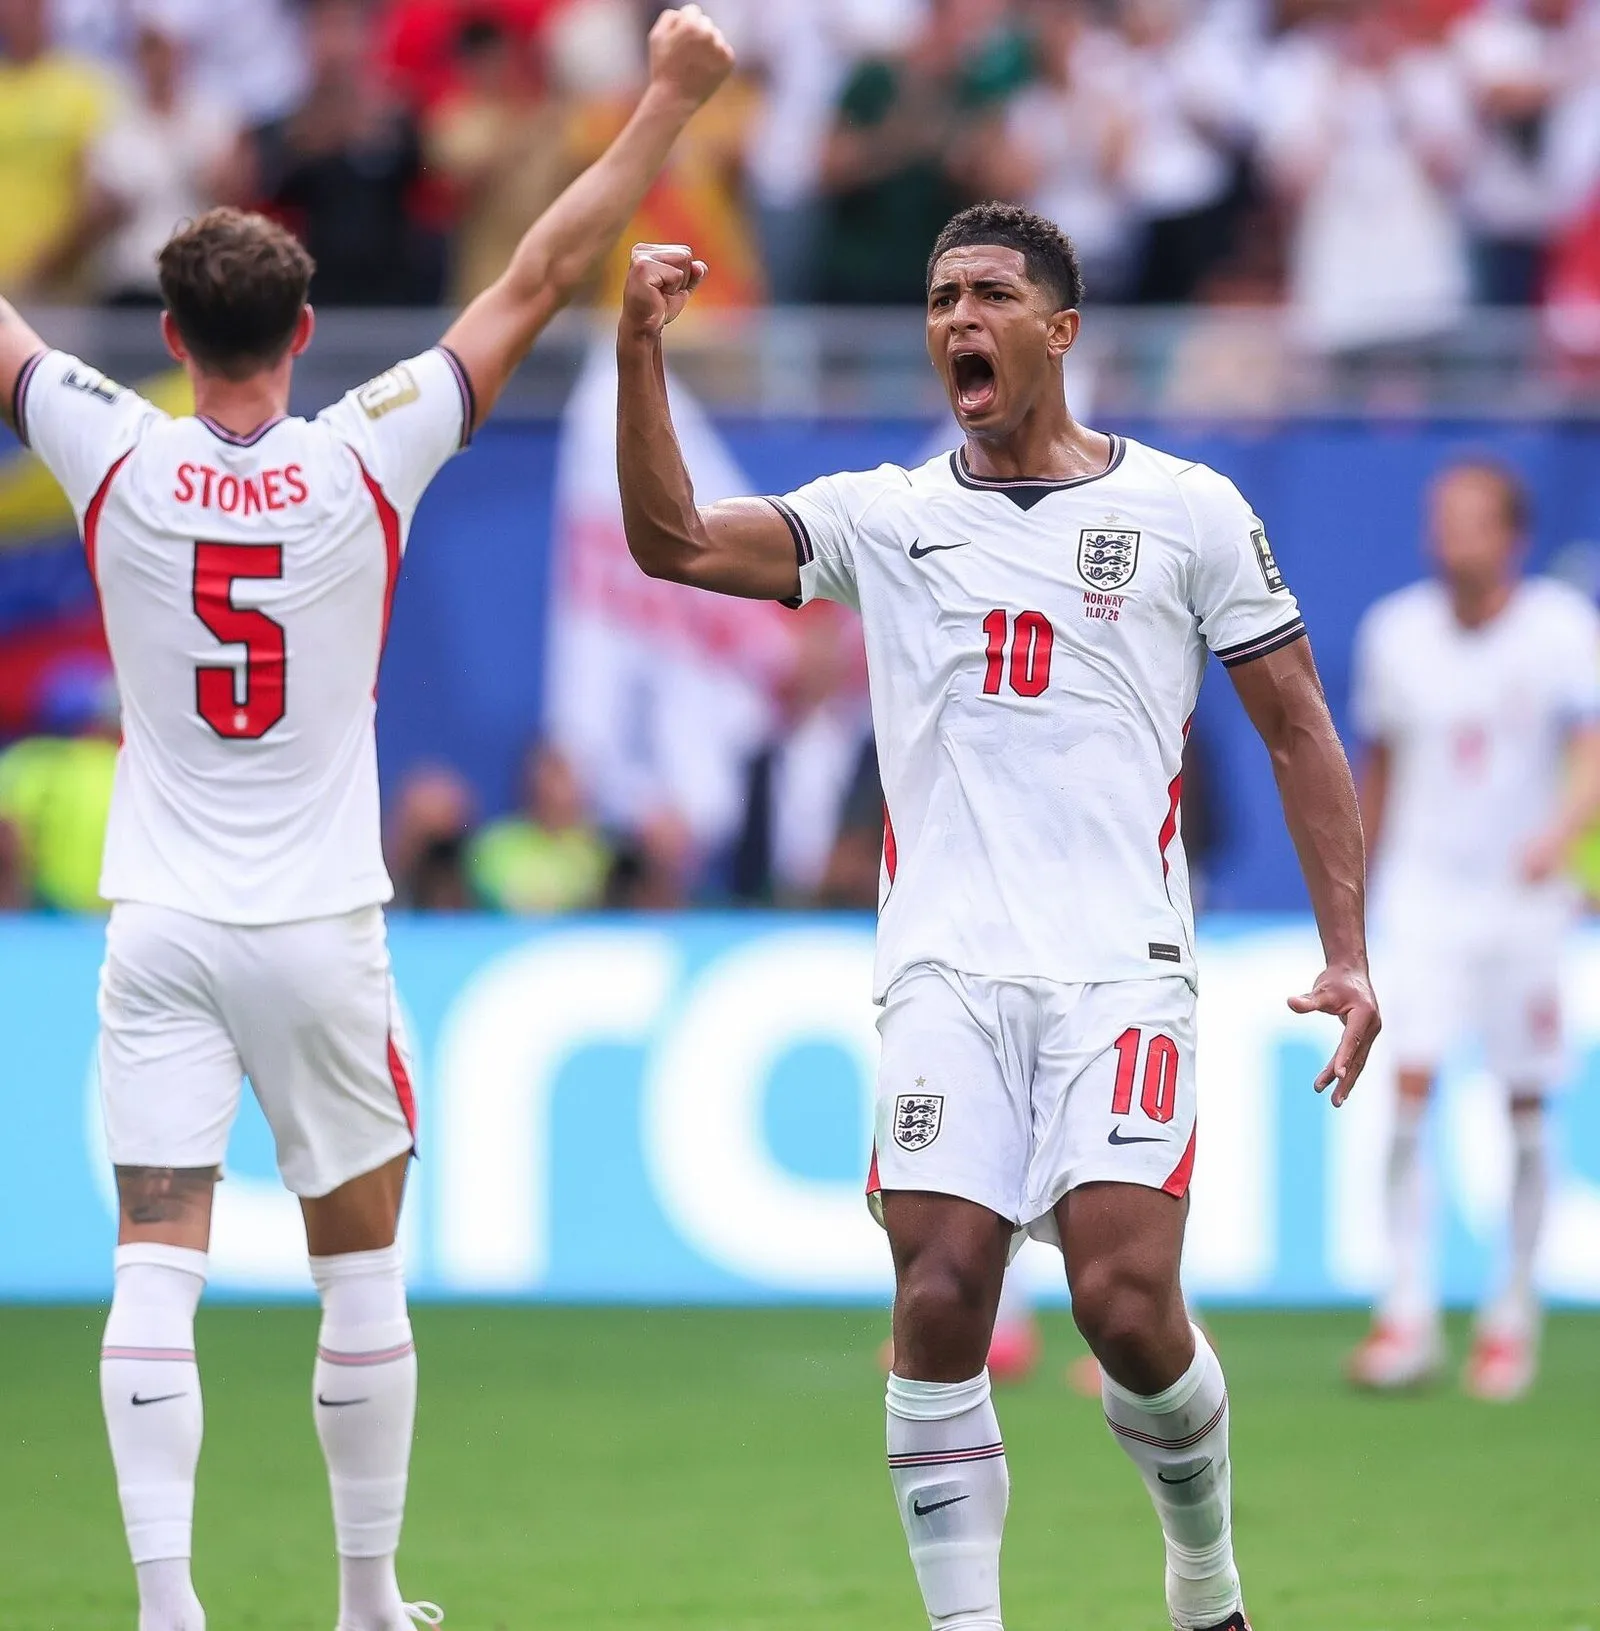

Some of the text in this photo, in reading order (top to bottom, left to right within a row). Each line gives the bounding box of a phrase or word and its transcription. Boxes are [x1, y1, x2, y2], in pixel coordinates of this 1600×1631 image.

[174, 463, 309, 516] STONES
[1083, 592, 1124, 608] NORWAY
[1085, 606, 1119, 621] 11.07.26
[193, 541, 286, 739] 5
[982, 609, 1055, 698] 10
[1111, 1027, 1180, 1124] 10
